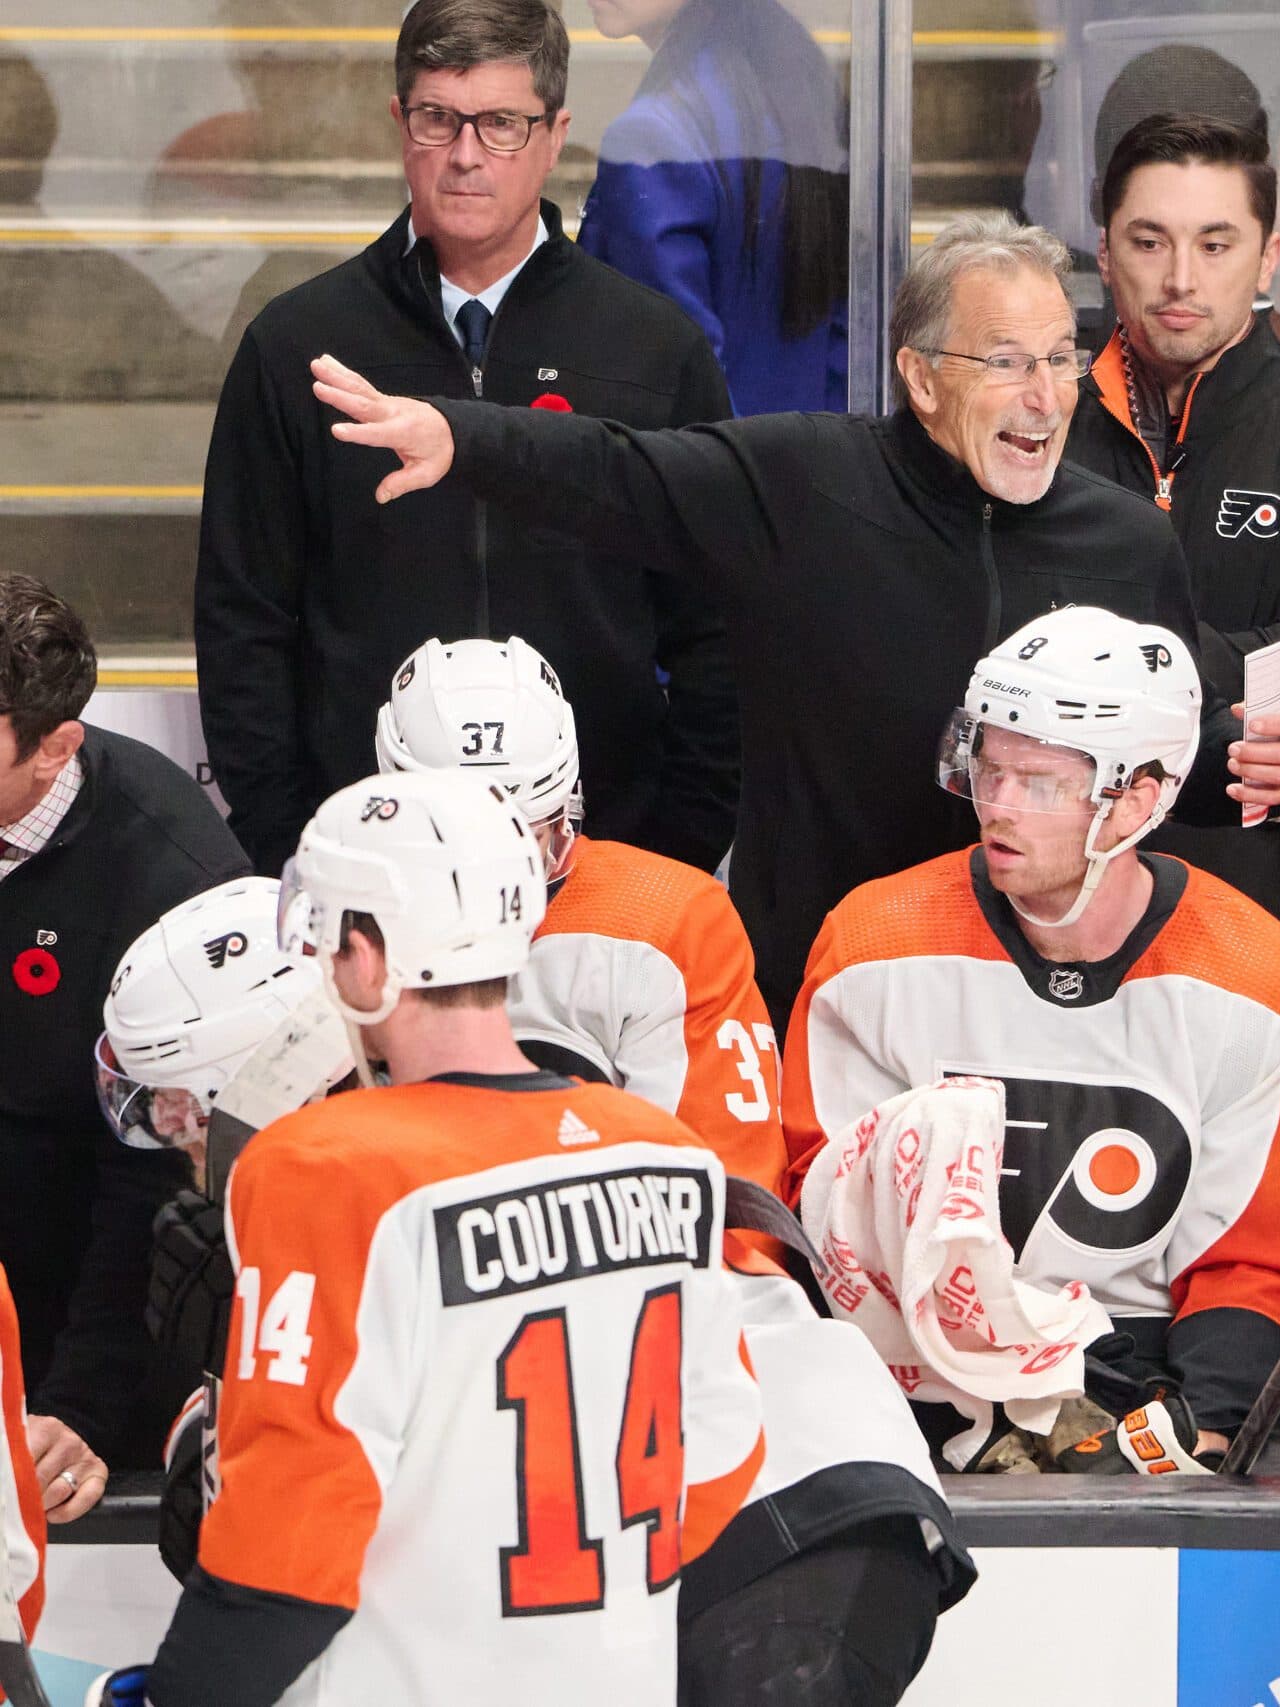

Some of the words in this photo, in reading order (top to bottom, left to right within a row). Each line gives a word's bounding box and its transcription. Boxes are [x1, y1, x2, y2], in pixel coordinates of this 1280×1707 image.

[1018, 637, 1048, 660] 8
[461, 721, 505, 756] 37
[499, 885, 521, 924] 14
[457, 1176, 701, 1293] COUTURIER
[236, 1266, 317, 1387] 14
[496, 1280, 685, 1618] 14
